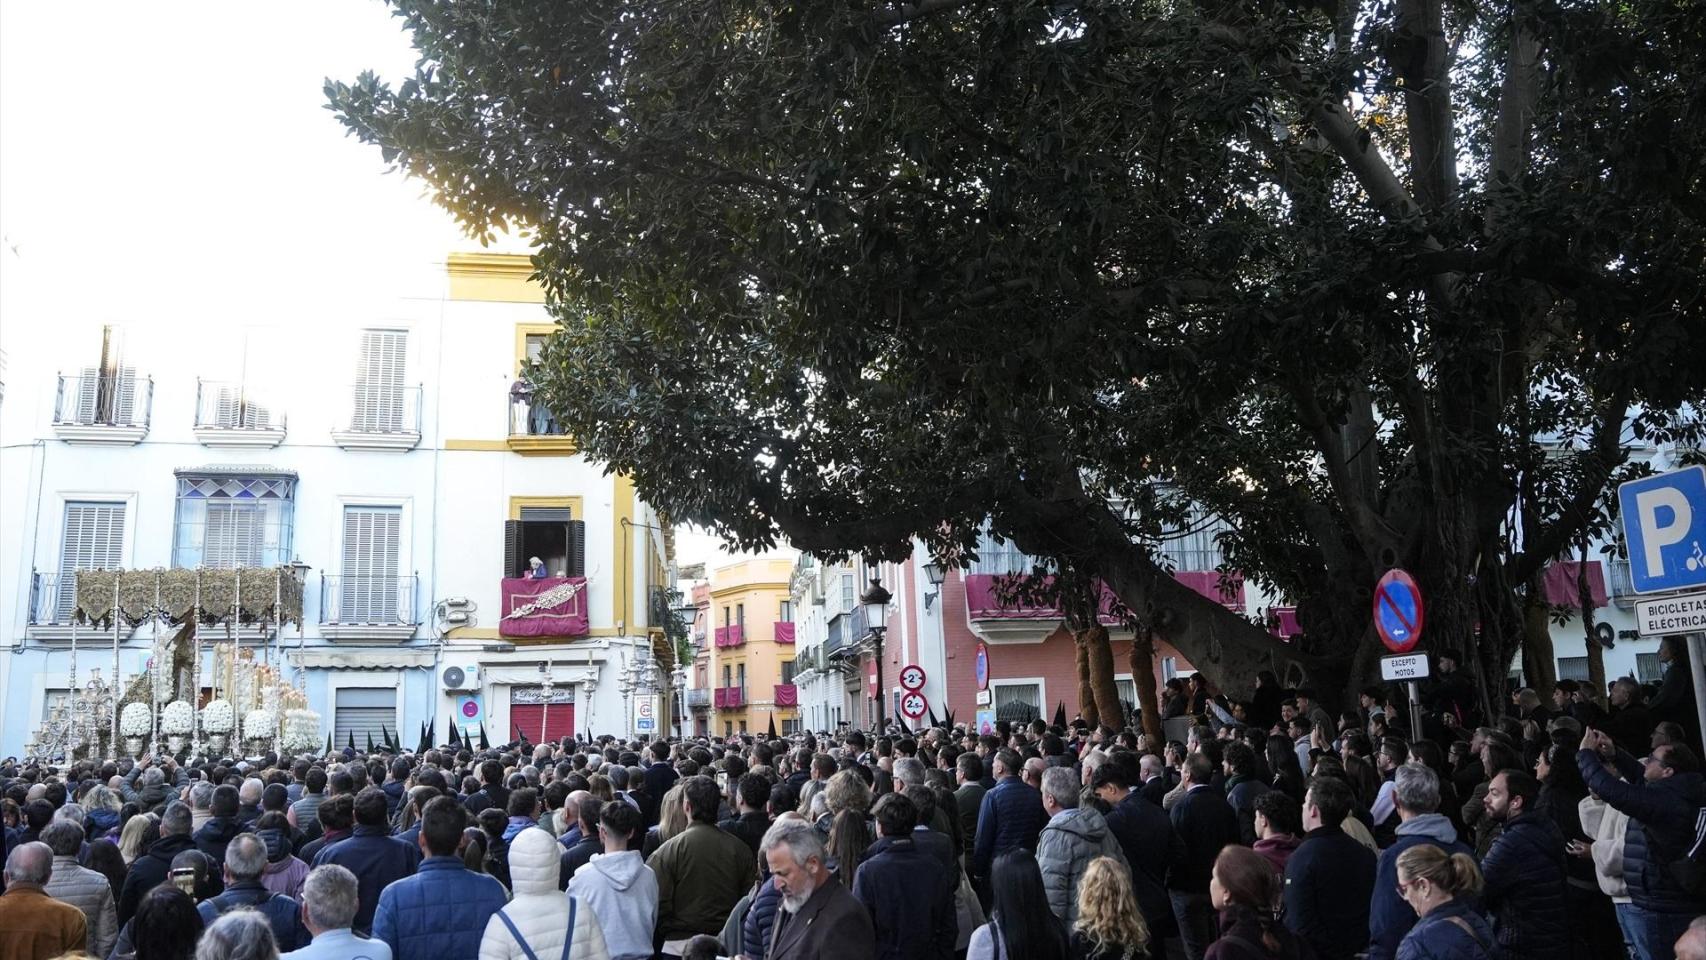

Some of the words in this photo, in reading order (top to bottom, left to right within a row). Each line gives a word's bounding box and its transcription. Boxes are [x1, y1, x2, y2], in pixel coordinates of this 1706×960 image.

[1636, 487, 1692, 577] P
[1391, 658, 1416, 667] EXCEPTO
[1395, 669, 1415, 677] MOTOS
